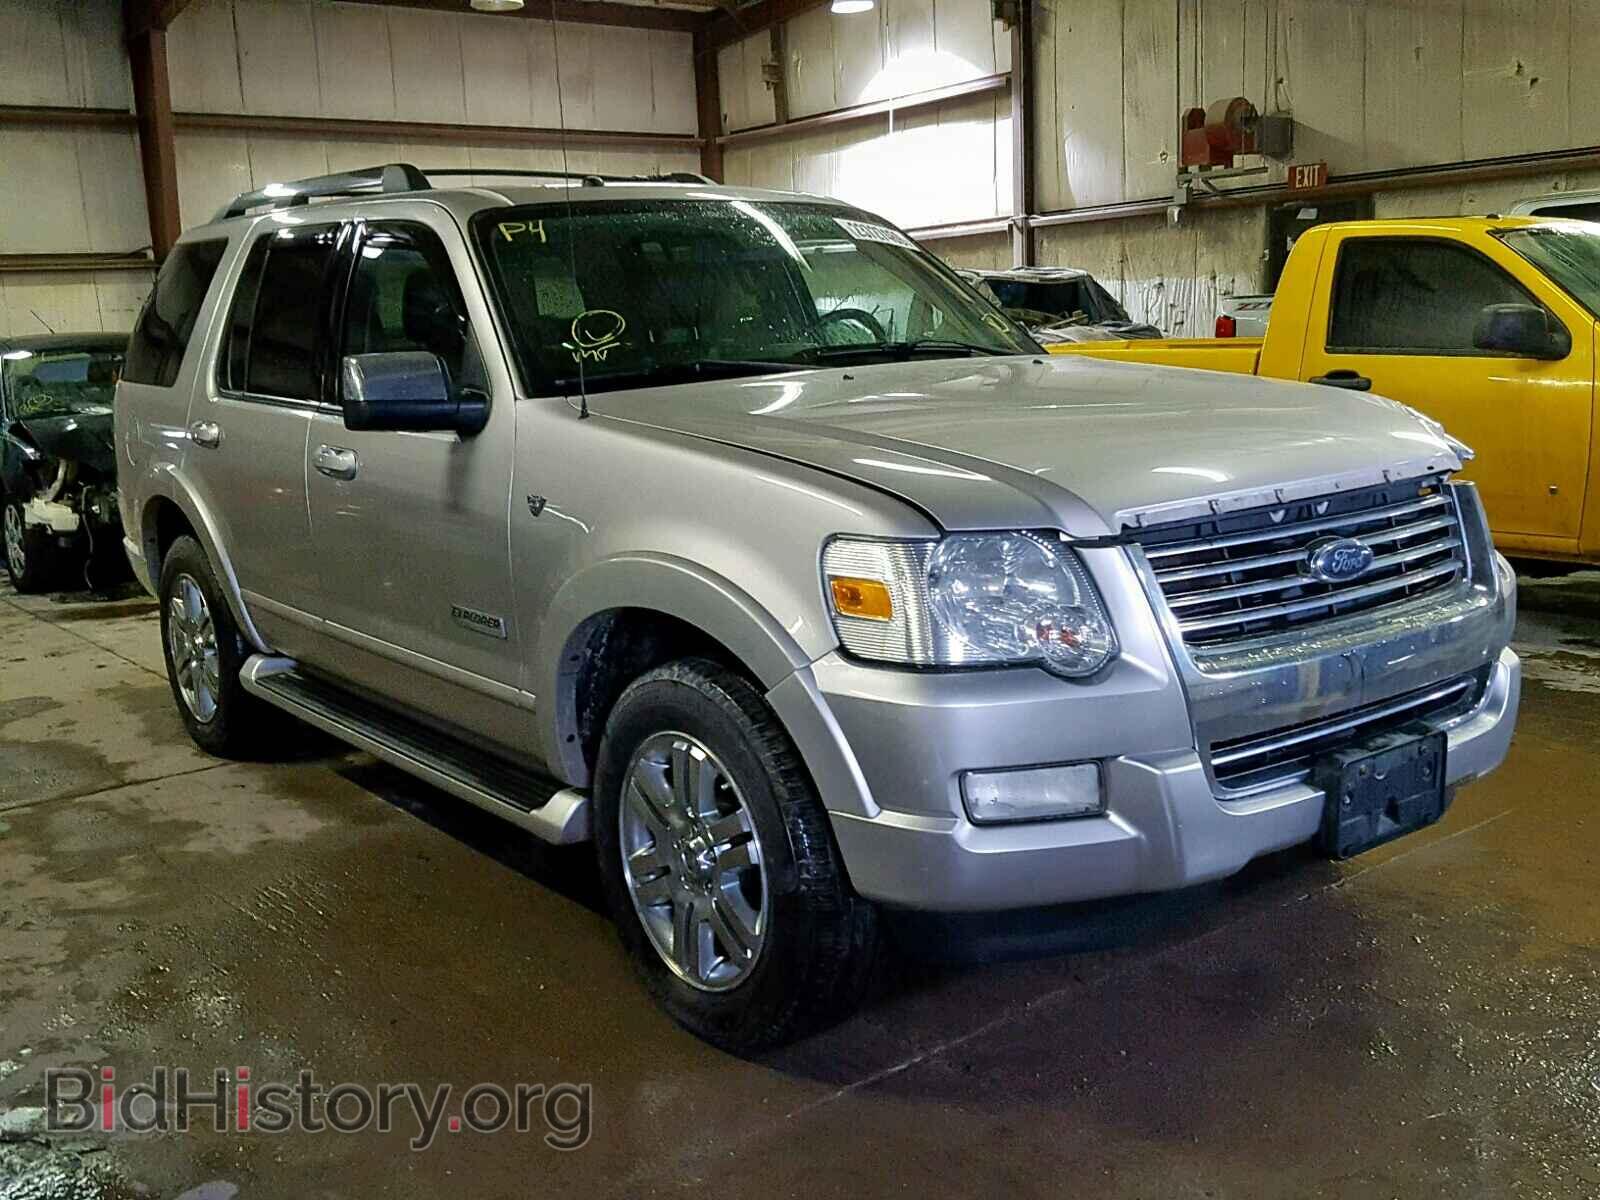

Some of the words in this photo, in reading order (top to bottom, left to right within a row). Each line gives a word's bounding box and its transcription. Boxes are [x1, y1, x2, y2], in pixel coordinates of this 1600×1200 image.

[1296, 164, 1320, 189] EXIT
[498, 220, 546, 243] P4
[1332, 548, 1363, 573] Ford
